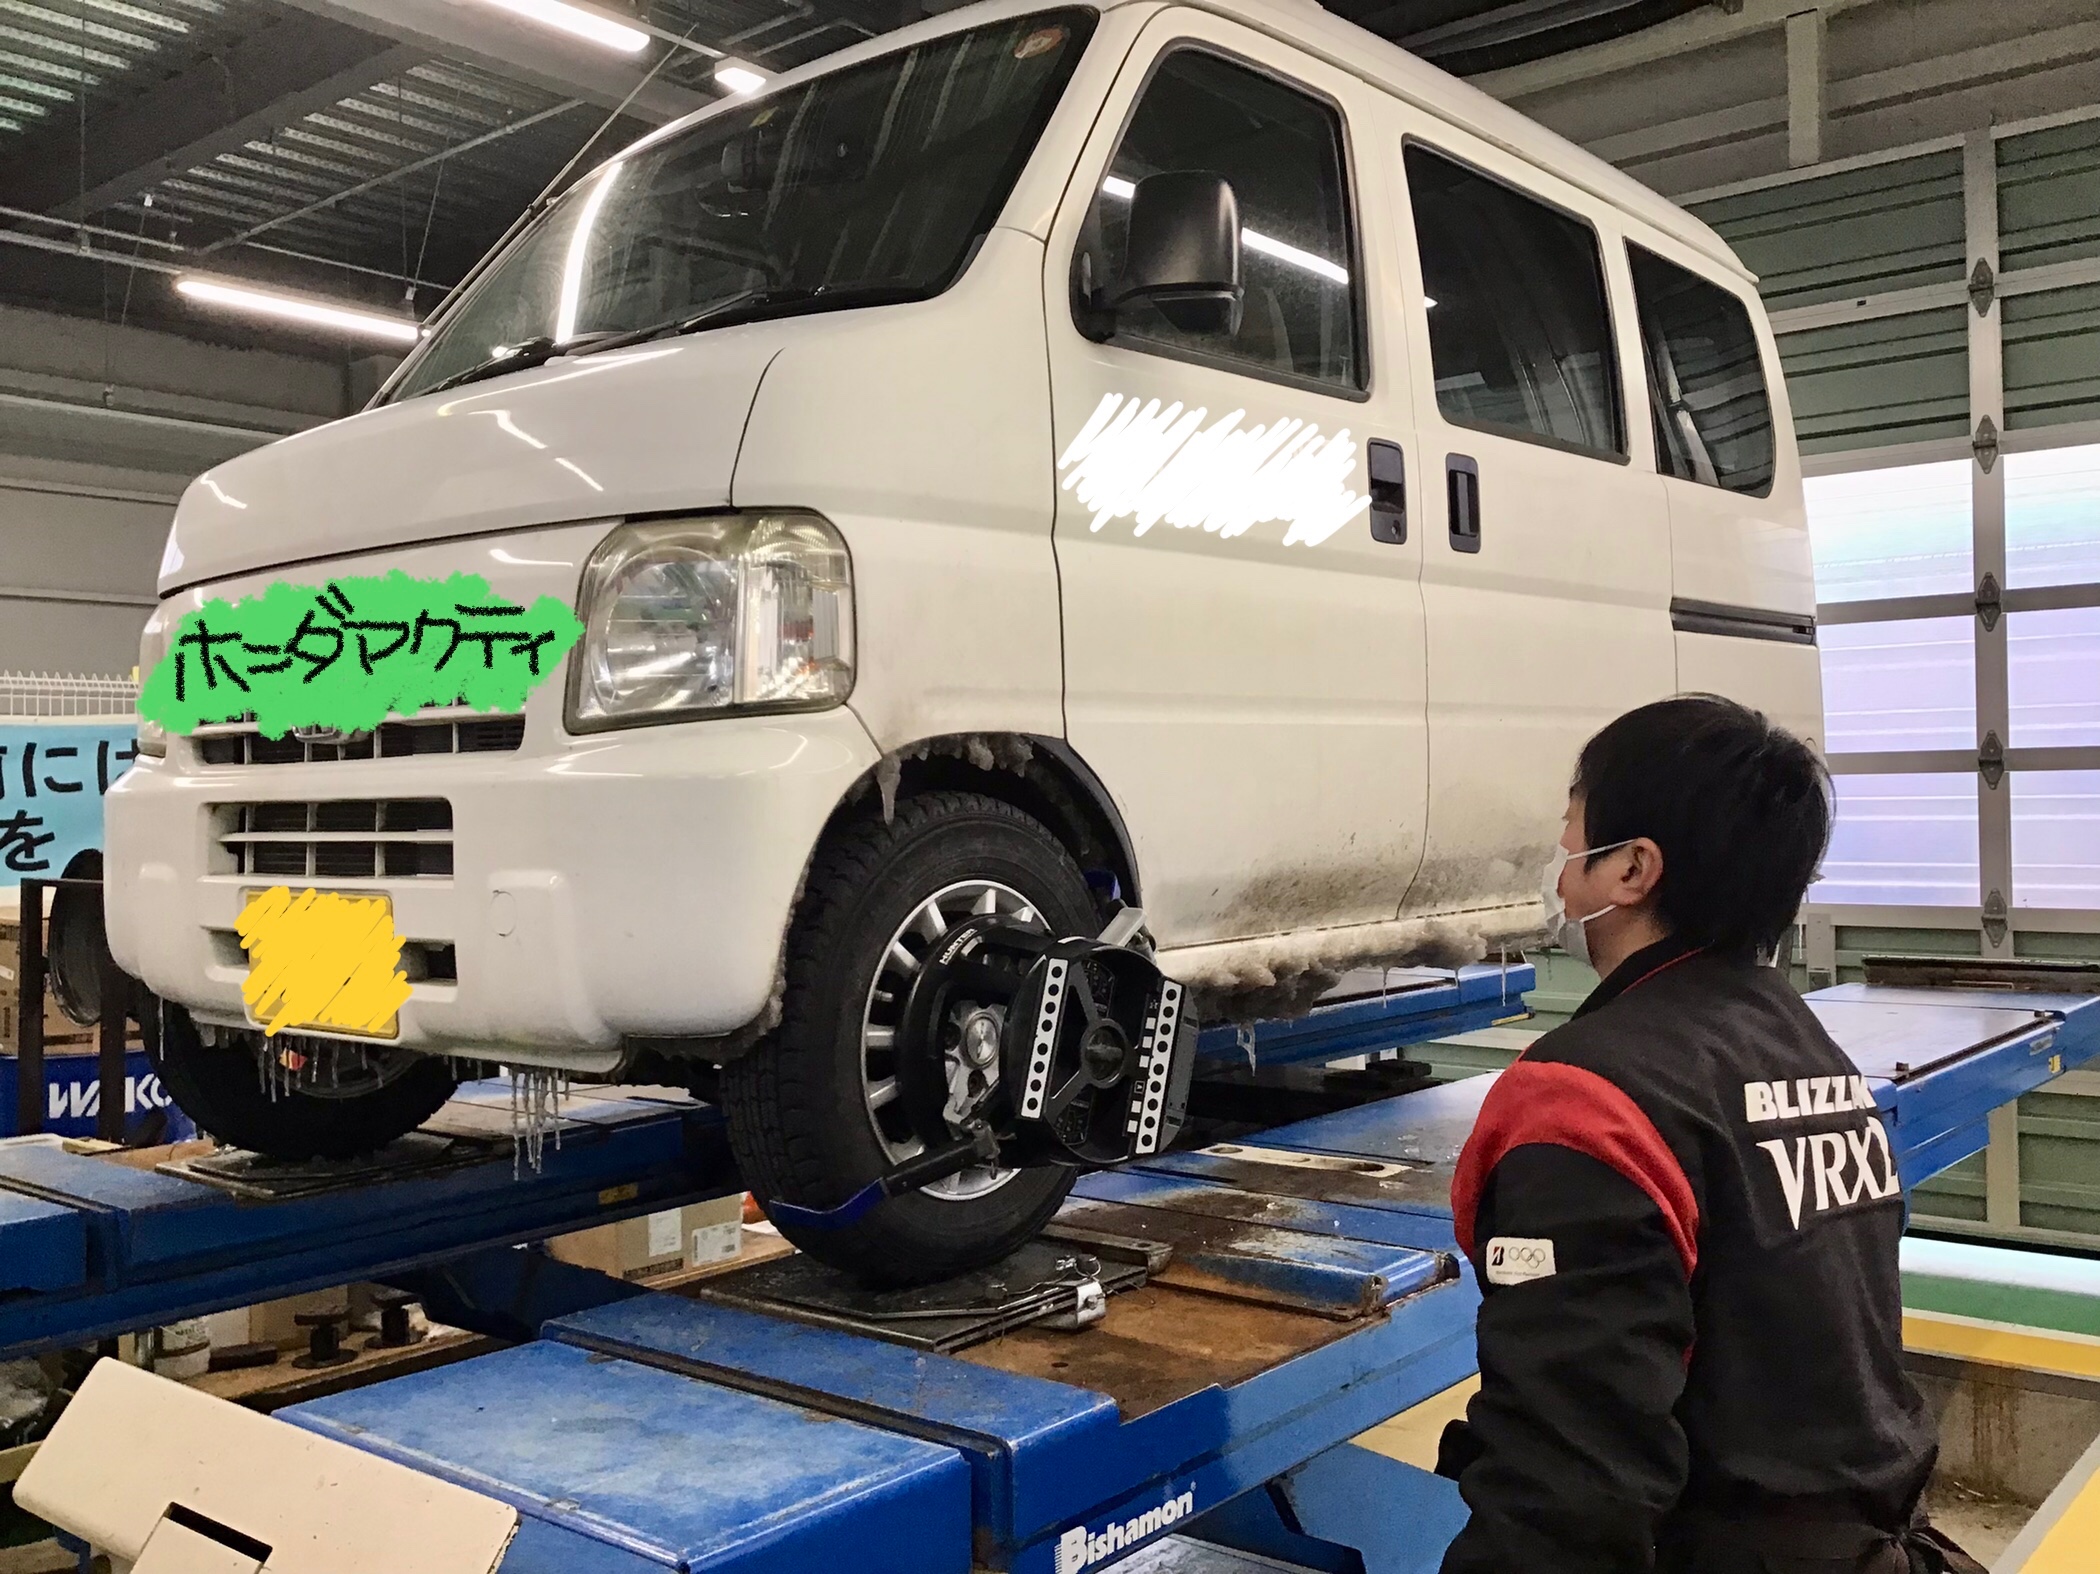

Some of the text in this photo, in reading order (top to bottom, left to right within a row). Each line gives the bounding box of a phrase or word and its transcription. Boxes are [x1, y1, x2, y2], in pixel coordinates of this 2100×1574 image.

[0, 738, 140, 799] には
[939, 928, 977, 965] HUNTER
[1755, 1116, 1900, 1231] VRX2
[1054, 1491, 1193, 1574] Bishamon
